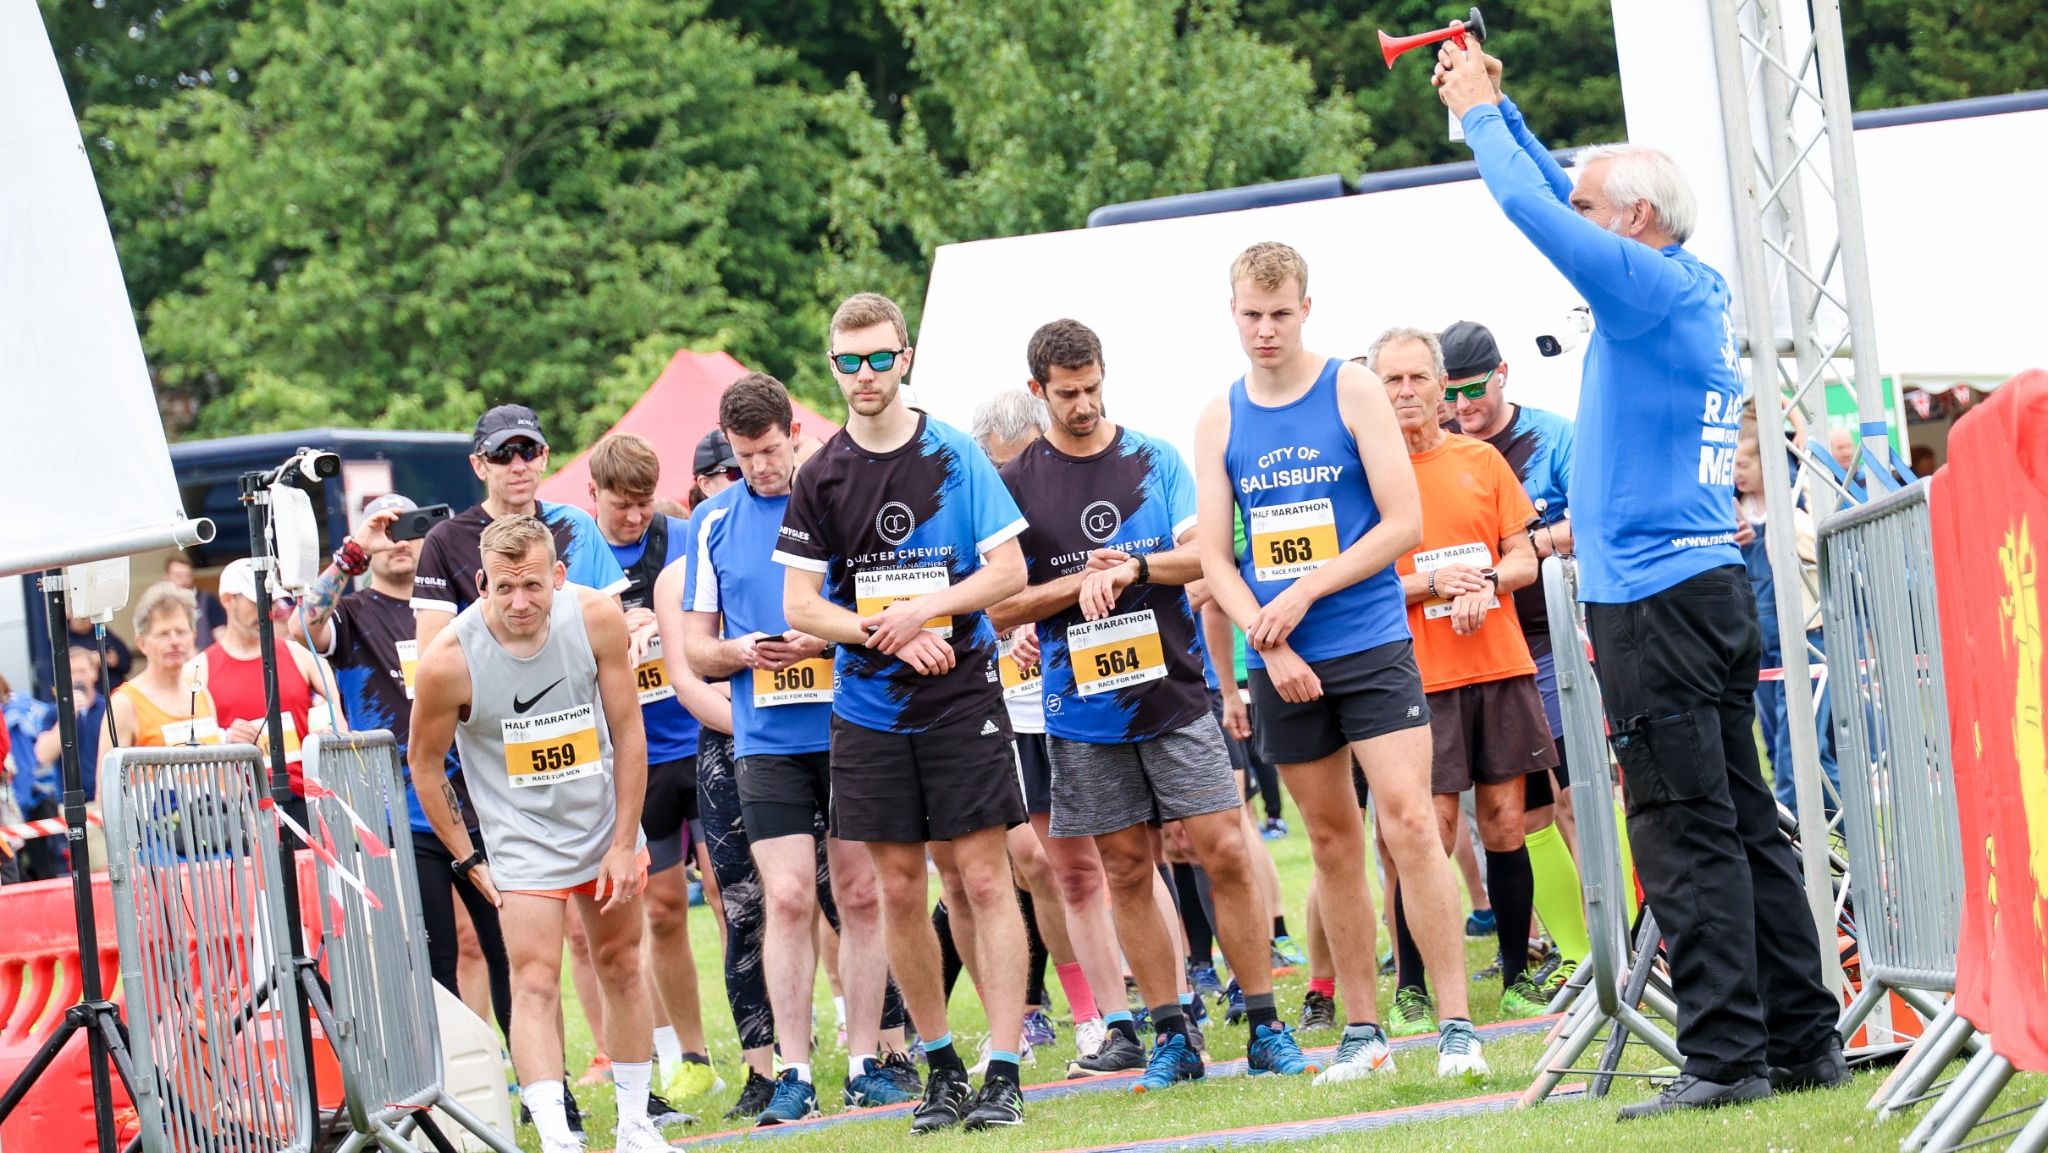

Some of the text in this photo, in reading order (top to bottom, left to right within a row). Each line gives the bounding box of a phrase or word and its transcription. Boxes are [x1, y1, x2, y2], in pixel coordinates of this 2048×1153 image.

[1257, 446, 1320, 469] CITY OF
[1240, 465, 1344, 494] SALISBURY
[1252, 501, 1329, 519] HALF MARATHON
[846, 546, 953, 568] QUILTER CHEVIOT
[1050, 549, 1096, 567] QUILTE
[1269, 536, 1313, 565] 563
[1416, 552, 1441, 564] HALF
[857, 570, 946, 584] HALF MARATHON
[1061, 563, 1088, 575] INVEST
[1069, 613, 1153, 638] HALF MARATHON
[1095, 647, 1140, 677] 564
[637, 667, 663, 690] 45
[773, 666, 815, 691] 560
[1098, 673, 1146, 688] RACE FOR MEN
[504, 707, 591, 730] HALF MARATHON
[531, 743, 576, 772] 559
